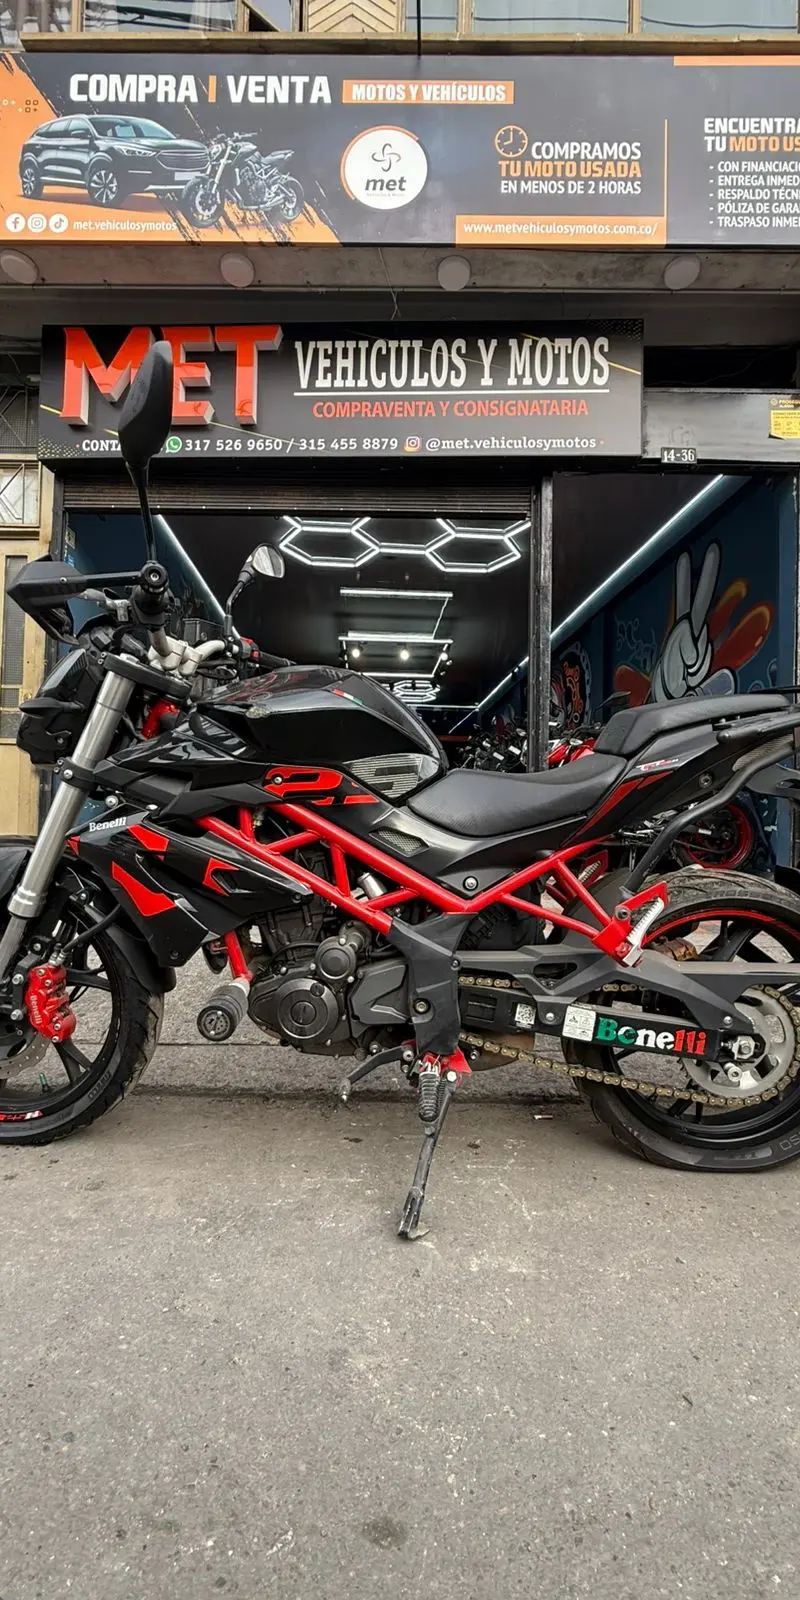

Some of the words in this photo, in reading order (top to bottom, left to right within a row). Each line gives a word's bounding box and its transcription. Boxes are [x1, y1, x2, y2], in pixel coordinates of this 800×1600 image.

[69, 73, 199, 104] COMPRA
[227, 74, 332, 104] VENTA
[351, 83, 407, 101] MOTOS
[408, 84, 419, 101] Y
[421, 81, 507, 102] VEHÍCULOS
[531, 141, 642, 161] COMPRAMOS
[703, 135, 727, 153] TU
[728, 136, 780, 153] MOTO
[498, 161, 522, 178] TU
[524, 161, 577, 178] MOTO
[580, 162, 642, 178] USADA
[717, 160, 740, 173] CON
[364, 176, 407, 191] met
[500, 180, 518, 194] EN
[520, 180, 566, 195] MENOS
[567, 180, 585, 195] DE
[587, 181, 596, 195] 2
[599, 181, 642, 195] HORAS
[717, 174, 765, 187] ENTREGA
[717, 188, 771, 201] RESPALDO
[717, 200, 755, 214] PÓLIZA
[756, 202, 770, 214] DE
[73, 220, 178, 232] met.vehiculosymotos
[463, 222, 658, 237] www.metvehiculosymotos.com.co/
[717, 215, 770, 228] TRASPASO
[771, 215, 800, 228] INME
[60, 325, 284, 426] MET
[294, 338, 467, 389] VEHICULOS
[477, 339, 497, 387] Y
[507, 336, 610, 387] MOTOS
[312, 401, 436, 418] COMPRAVENTA
[440, 402, 449, 416] Y
[453, 400, 588, 417] CONSIGNATARIA
[185, 439, 211, 451] 317
[216, 439, 242, 451] 526
[247, 438, 282, 451] 9650
[299, 438, 325, 450] 315
[331, 438, 358, 450] 455
[362, 438, 398, 450] 8879
[425, 436, 597, 452] @met.vehiculosymotos
[662, 448, 696, 463] 14-36
[88, 816, 128, 832] Benelli
[29, 994, 44, 1025] Benelli
[596, 1017, 707, 1055] Benelli
